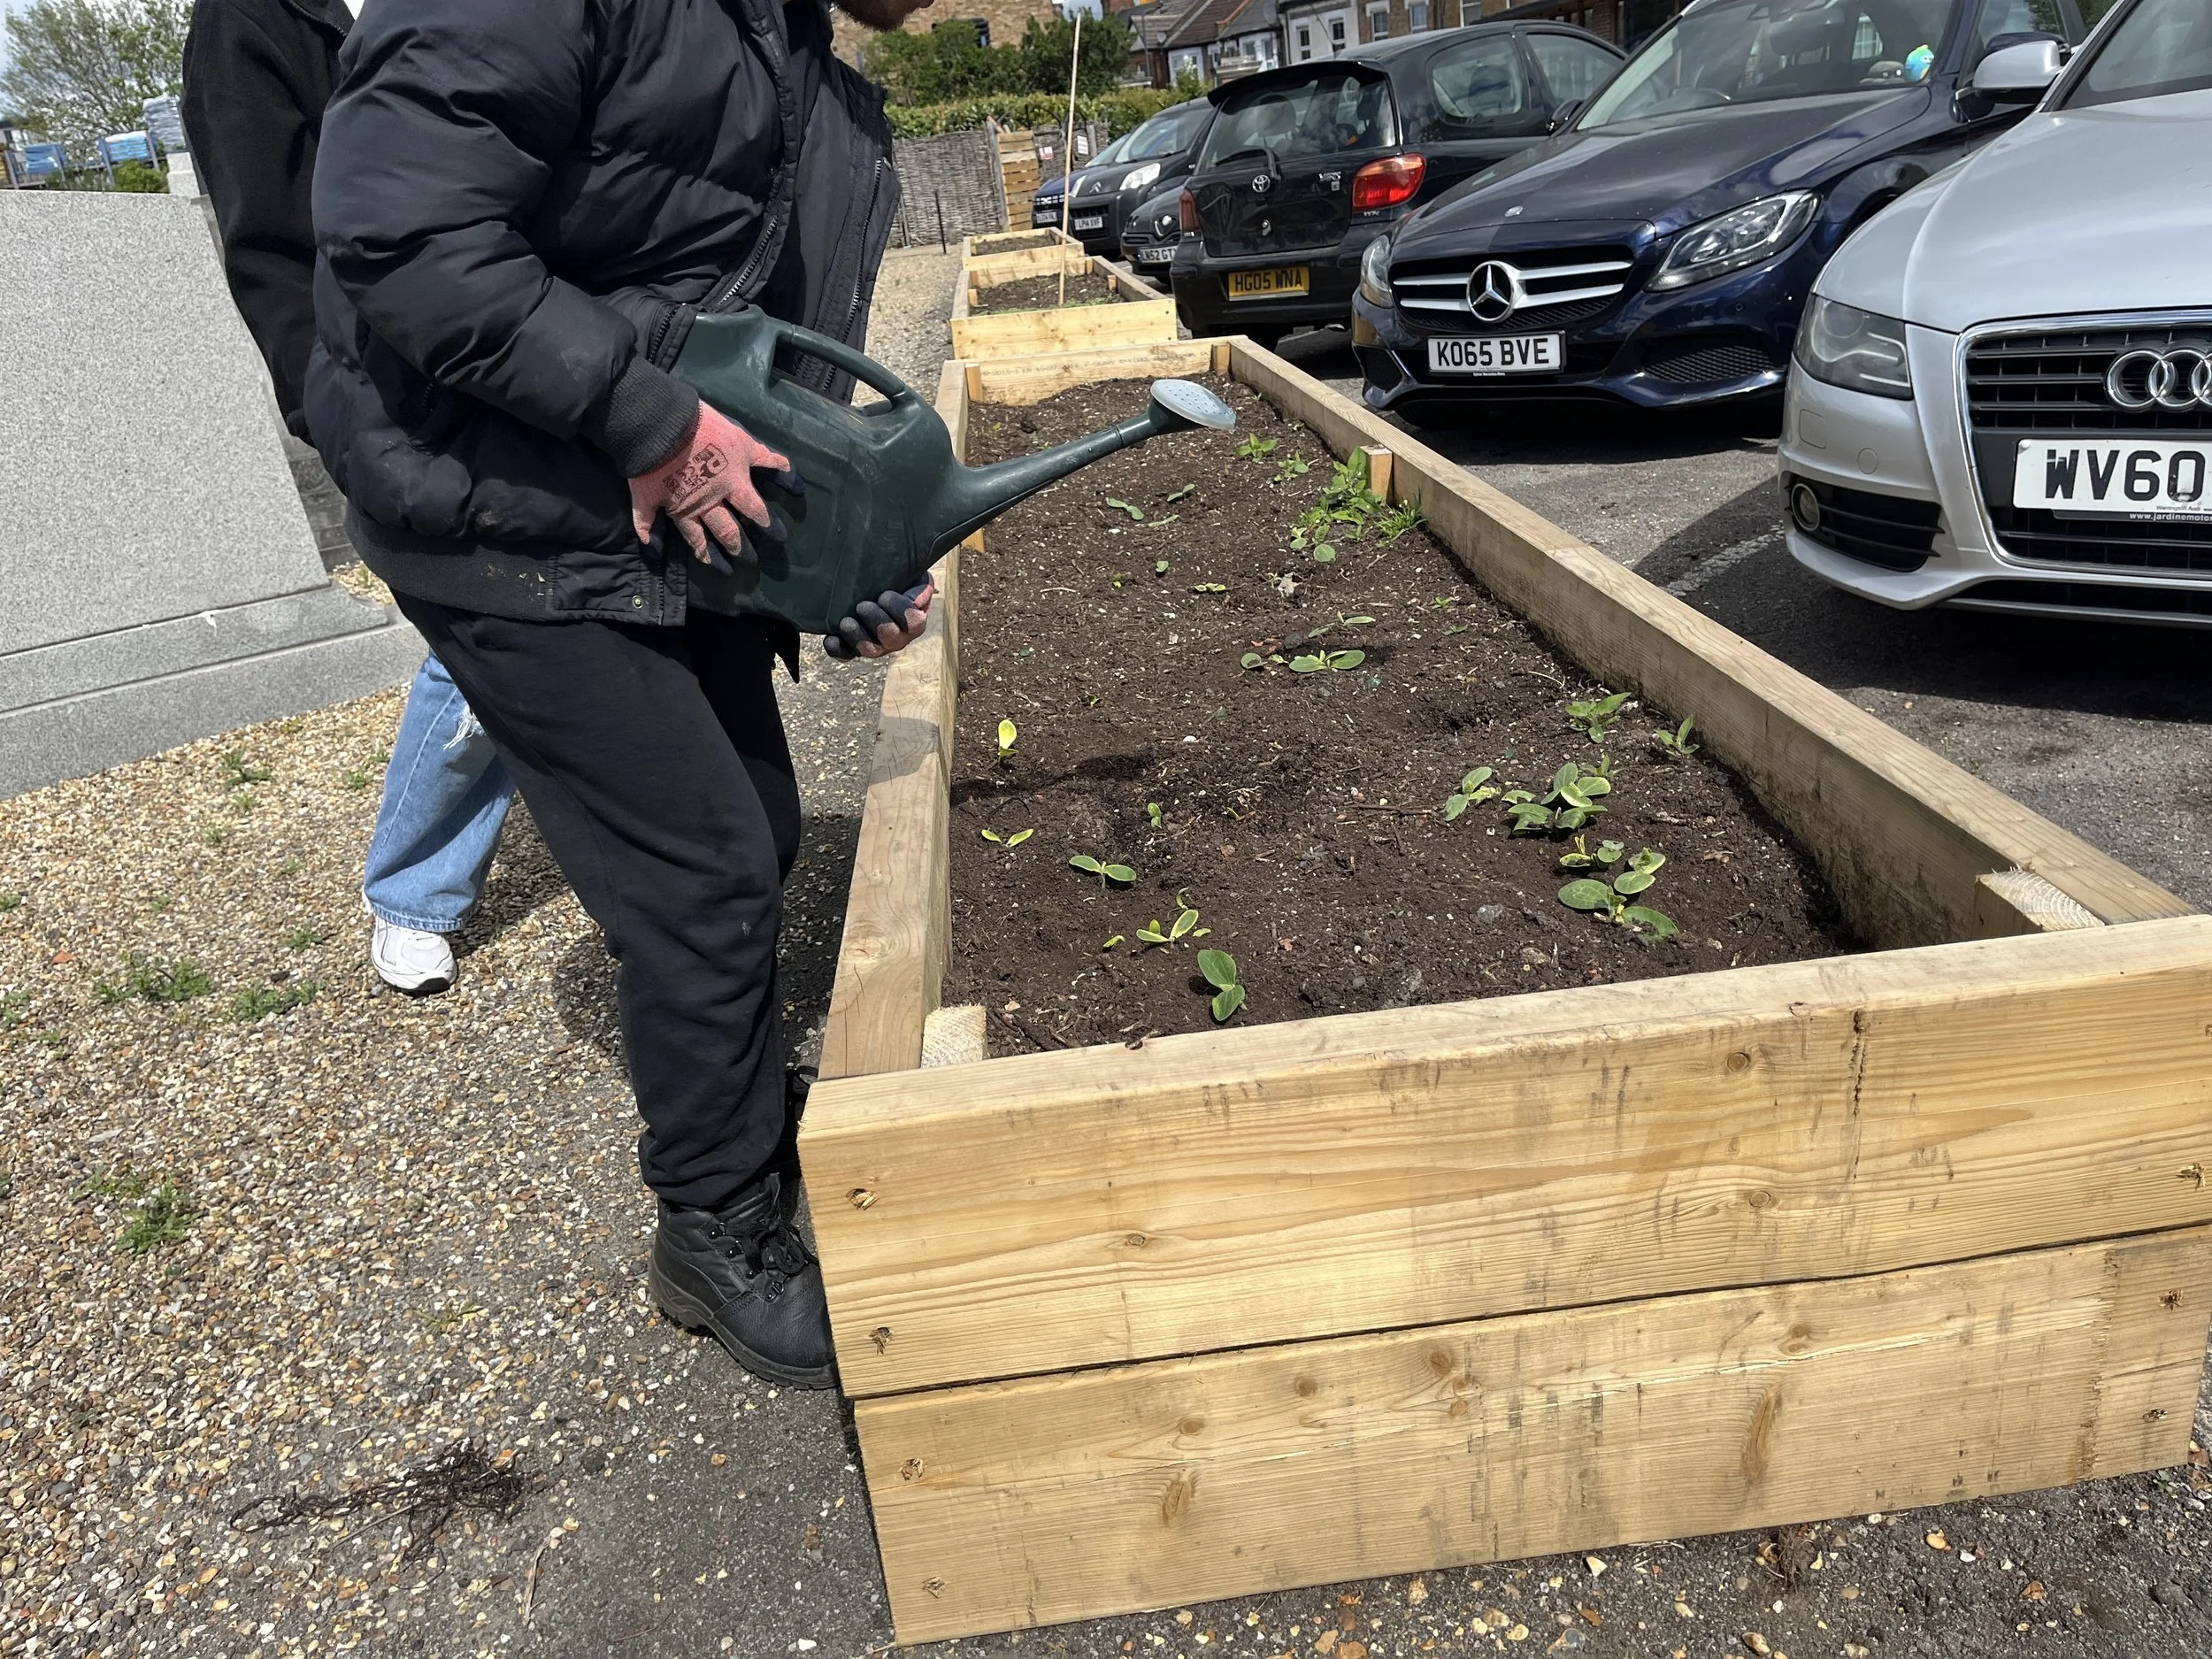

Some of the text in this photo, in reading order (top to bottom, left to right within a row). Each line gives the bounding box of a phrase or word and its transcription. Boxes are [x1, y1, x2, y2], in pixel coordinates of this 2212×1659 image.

[1234, 269, 1302, 292] HG05 WNA
[1437, 338, 1549, 366] KO65 BVE
[2045, 449, 2206, 503] WV60
